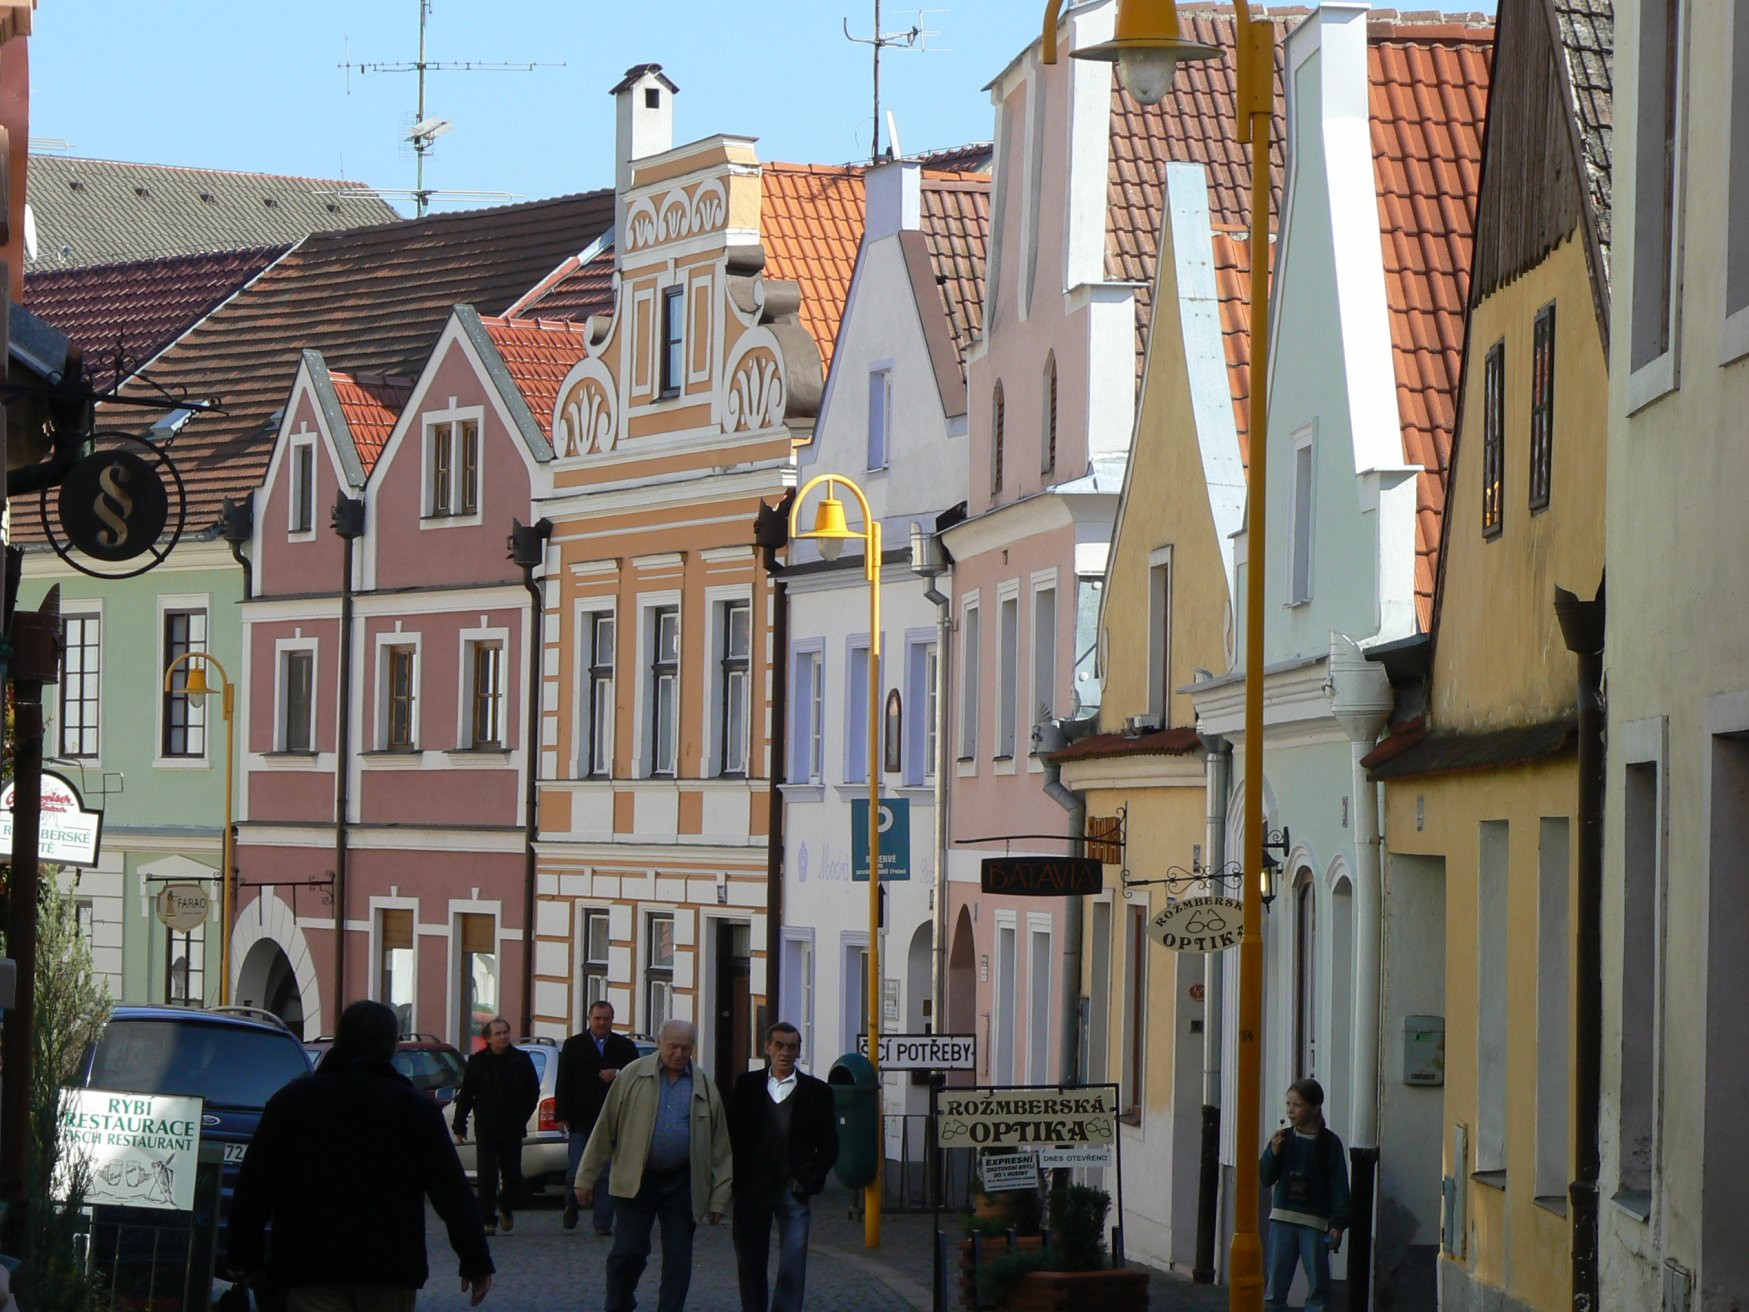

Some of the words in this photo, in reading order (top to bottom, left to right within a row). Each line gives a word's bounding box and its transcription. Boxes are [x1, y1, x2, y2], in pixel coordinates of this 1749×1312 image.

[3, 823, 92, 844] RBERSKÉ
[989, 863, 1096, 889] BATAVIA
[177, 897, 207, 909] FARAO
[1155, 896, 1244, 927] ROŽMBERSK
[860, 1038, 892, 1061] ŠCÍ
[897, 1038, 971, 1062] POTŘEBY
[108, 1097, 153, 1116] RYBÍ
[947, 1094, 1106, 1116] ROŽMBERSKÁ
[64, 1111, 194, 1137] RESTAURACE
[969, 1120, 1090, 1143] OPTIKA
[107, 1132, 193, 1151] RESTAURANT
[986, 1155, 1034, 1166] EXPRESNÍ
[1043, 1155, 1064, 1163] DNES
[1066, 1153, 1108, 1162] OTEVŘENO
